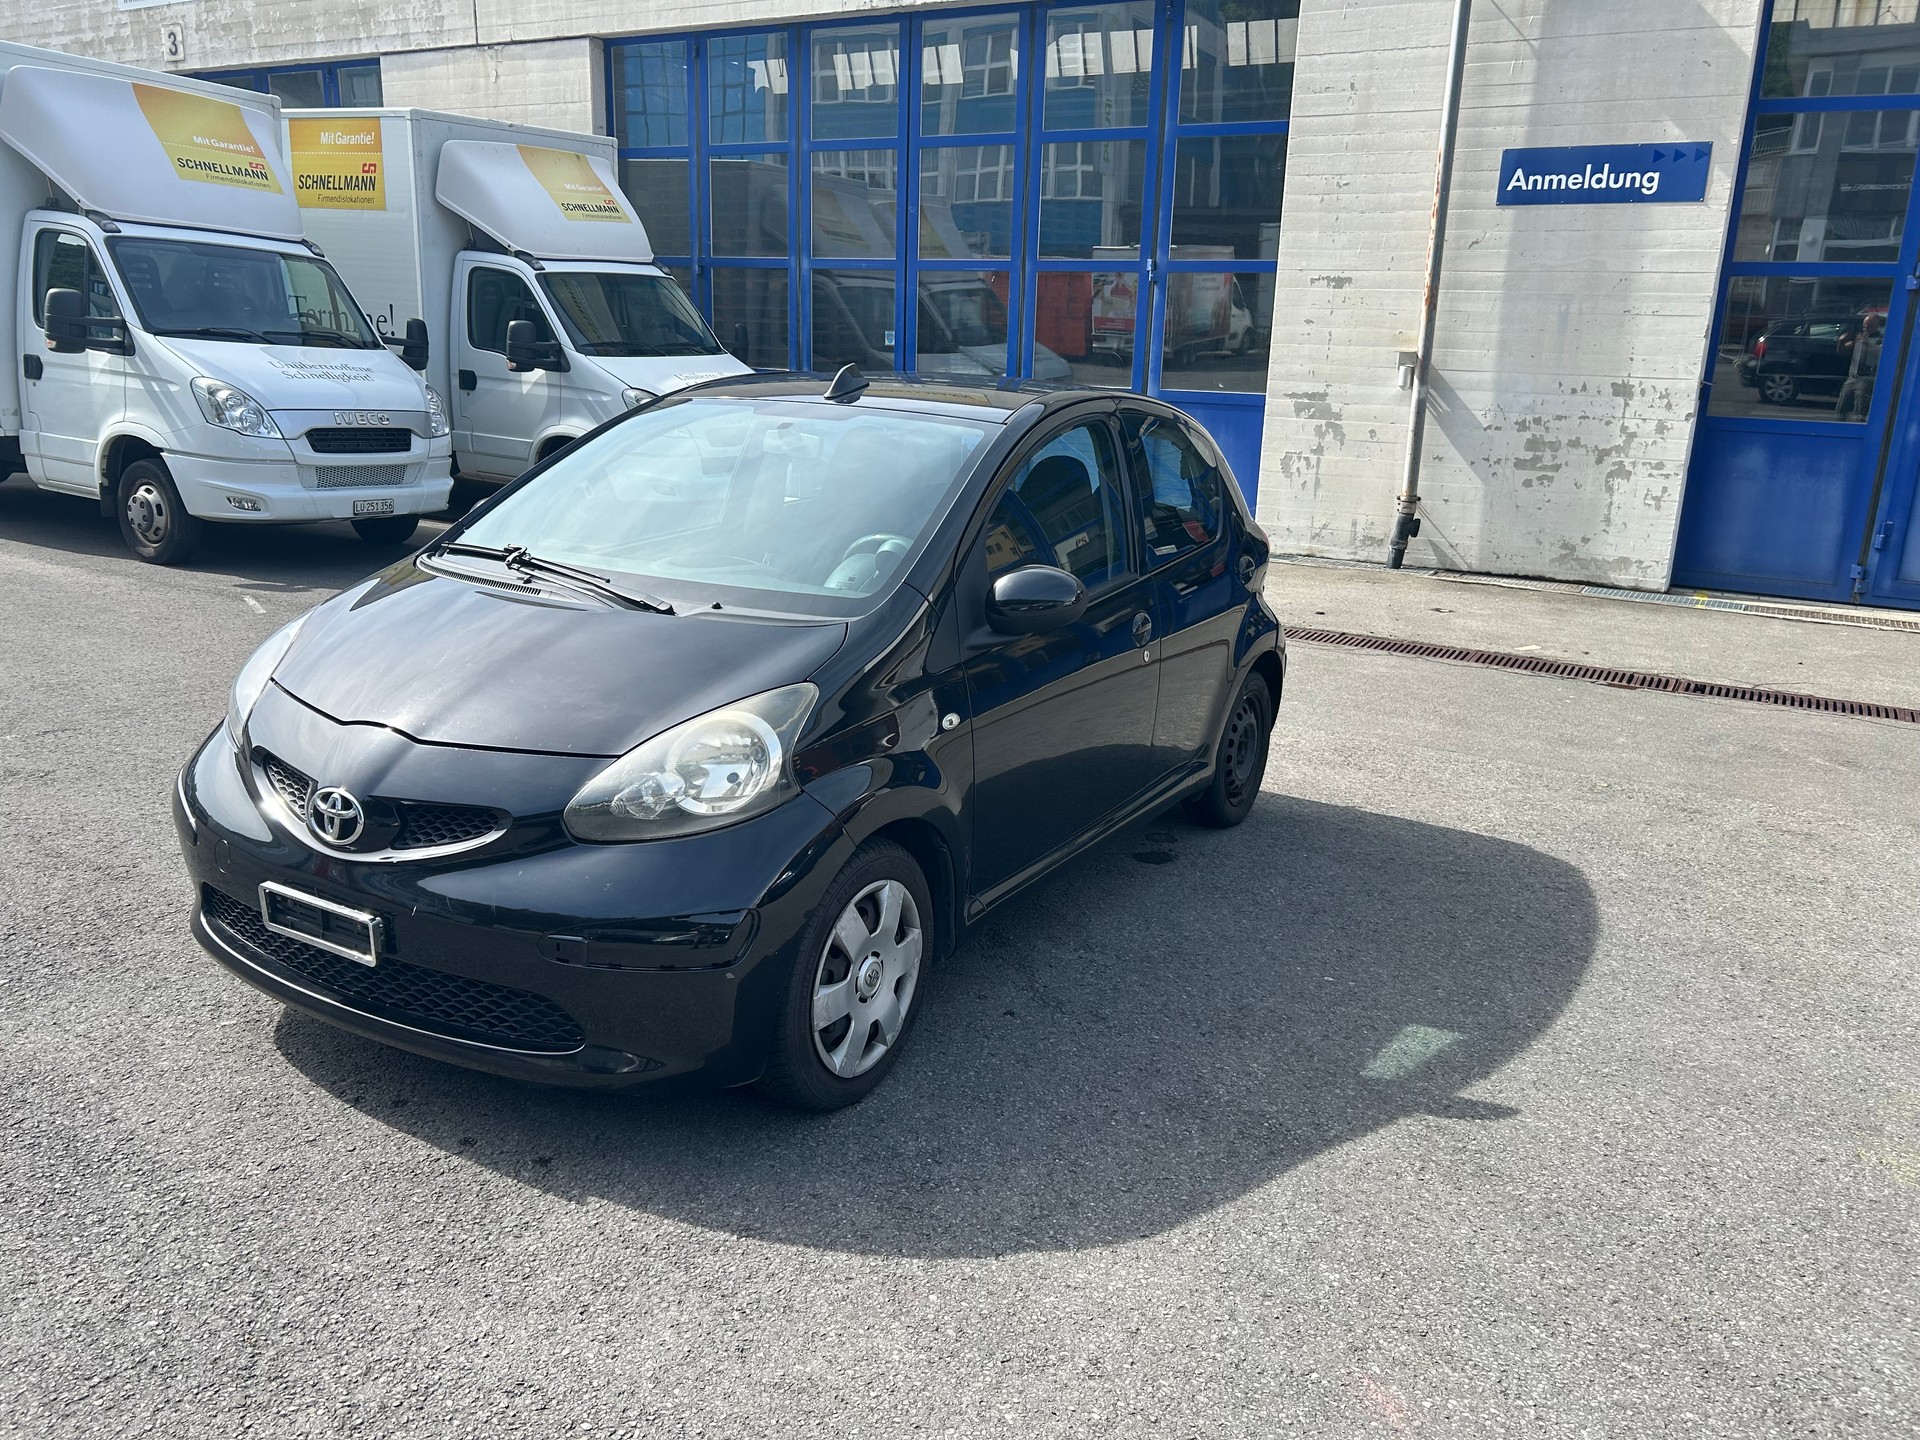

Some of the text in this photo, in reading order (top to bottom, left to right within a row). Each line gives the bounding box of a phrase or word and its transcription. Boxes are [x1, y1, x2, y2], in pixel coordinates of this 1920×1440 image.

[168, 31, 178, 56] 3
[192, 135, 256, 154] Mit Garantie!
[320, 131, 375, 145] Mit Garantie!
[176, 157, 269, 181] SCHNELLMANN
[298, 174, 377, 192] SCHNELLMANN
[1506, 163, 1660, 195] Anmeldung
[317, 194, 375, 205] Firmendislokationen
[561, 202, 620, 214] SCHNELLMANN
[333, 411, 390, 425] IVECO
